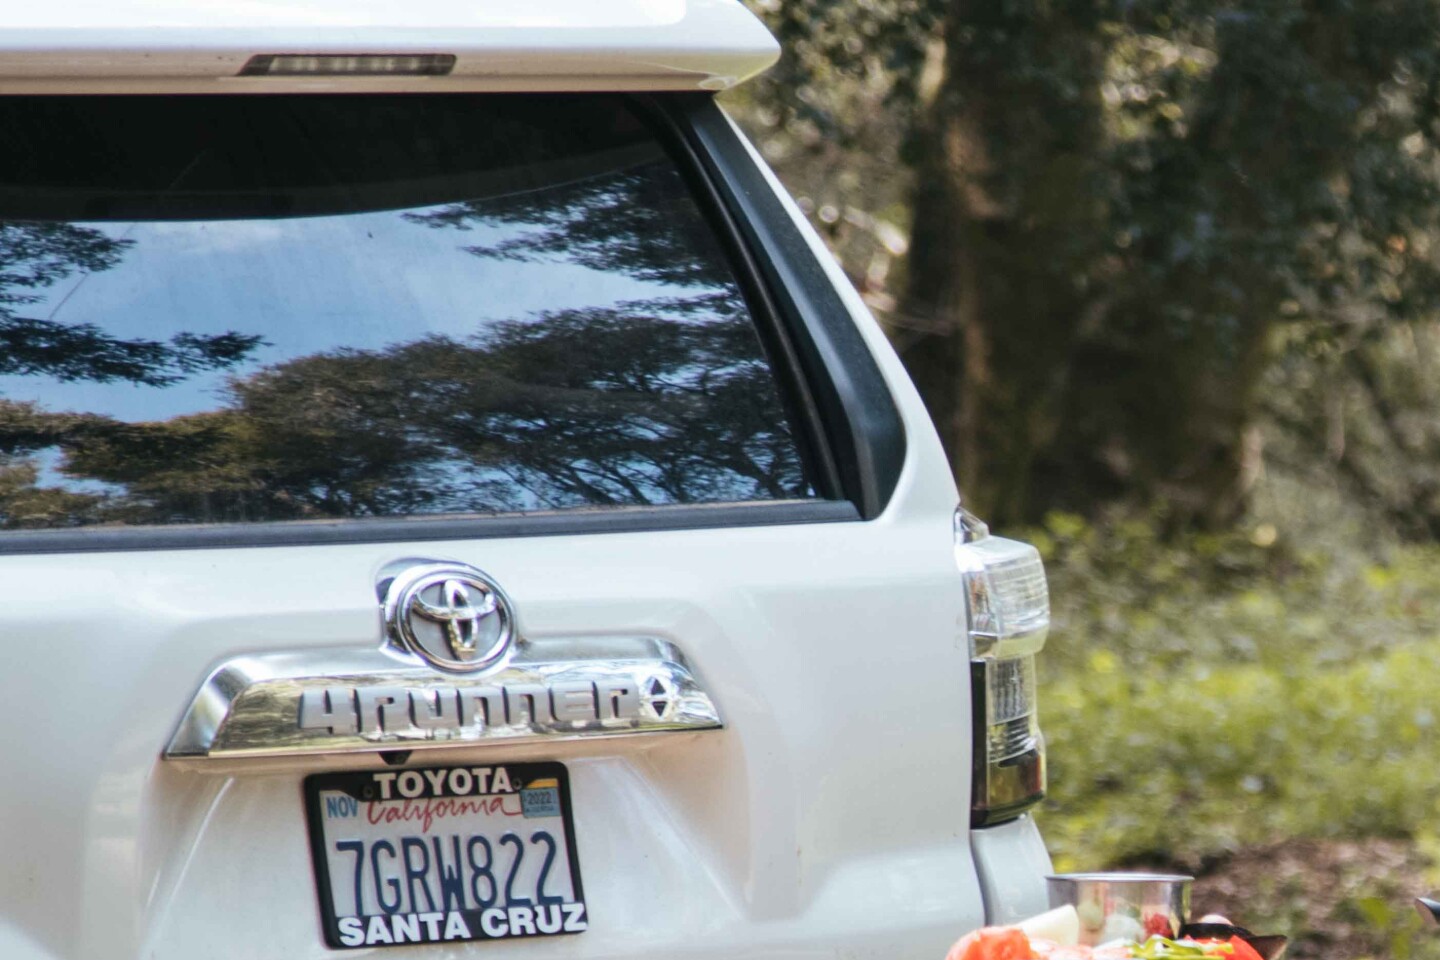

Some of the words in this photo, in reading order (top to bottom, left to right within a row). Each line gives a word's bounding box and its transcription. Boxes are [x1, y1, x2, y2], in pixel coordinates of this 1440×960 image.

[373, 767, 513, 799] TOYOTA
[325, 796, 358, 818] NOV
[367, 797, 523, 833] California
[336, 831, 563, 917] 7GRW822
[338, 911, 471, 946] SANTA
[481, 903, 588, 935] CRUZ
